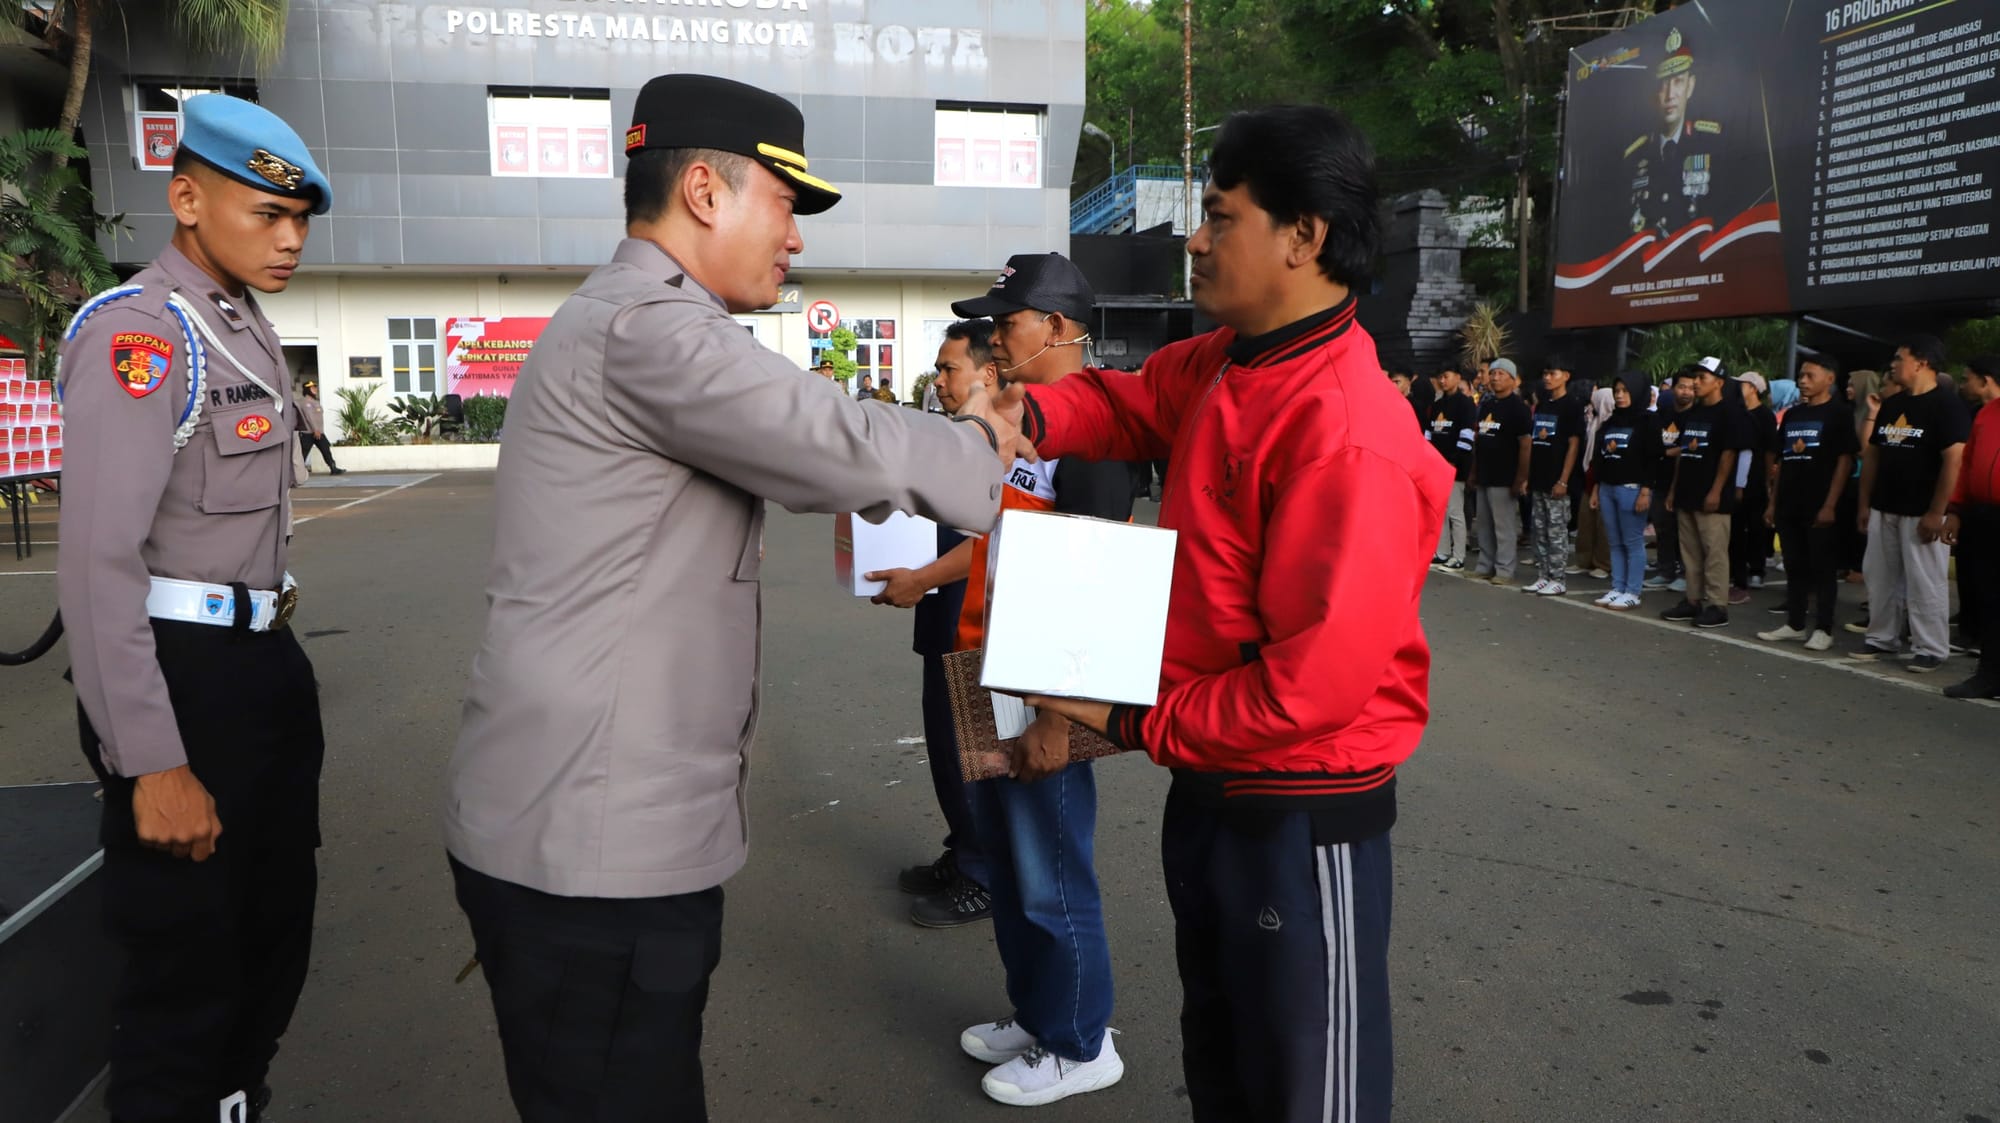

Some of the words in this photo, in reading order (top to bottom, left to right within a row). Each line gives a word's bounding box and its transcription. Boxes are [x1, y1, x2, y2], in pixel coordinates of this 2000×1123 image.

[448, 10, 596, 38] POLRESTA
[605, 15, 729, 43] MALANG
[737, 21, 809, 47] KOTA
[1825, 8, 1841, 33] 16
[1843, 0, 1915, 27] PROGR
[1836, 38, 1867, 56] PENATAAN
[1867, 23, 1915, 46] KELEMBAGAAN
[1872, 46, 1895, 61] SISTEM
[1910, 32, 1938, 50] METODE
[1938, 19, 1982, 41] ORGANISASI
[1887, 57, 1907, 73] POLRI
[1908, 52, 1926, 67] YANG
[1926, 45, 1954, 61] UNGGUL
[1964, 37, 1979, 51] ERA
[1869, 74, 1905, 93] TEKNOLOGI
[1904, 64, 1944, 84] KEPOLISIAN
[1898, 79, 1951, 102] PEMELIHARAAN
[1951, 67, 1996, 88] KAMTIBMAS
[1898, 98, 1938, 117] PENEGAKAN
[1938, 91, 1965, 108] HUKUM
[1905, 117, 1926, 132] POLRI
[1926, 111, 1951, 127] DALAM
[1893, 135, 1926, 150] NASIONAL
[1926, 129, 1947, 145] (PEN)
[1895, 149, 1928, 166] PROGRAM
[1928, 142, 1965, 159] PRIORITAS
[1904, 165, 1933, 180] KONFLIK
[1933, 160, 1958, 175] SOSIAL
[1866, 188, 1896, 202] KUALITAS
[1896, 181, 1935, 198] PELAYANAN
[1935, 176, 1961, 191] PUBLIK
[1961, 172, 1982, 187] POLRI
[1865, 202, 1903, 219] PELAYANAN
[1902, 199, 1922, 213] POLRI
[1922, 196, 1941, 209] YANG
[1941, 188, 1992, 206] TERINTEGRASI
[1903, 215, 1928, 229] PUBLIK
[1895, 231, 1929, 246] TERHADAP
[1929, 227, 1954, 241] SETIAP
[1954, 223, 1990, 238] KEGIATAN
[1876, 265, 1919, 280] MASYARAKAT
[1919, 261, 1949, 275] PENCARI
[1949, 257, 1985, 272] KEADILAN
[817, 308, 832, 325] P
[115, 334, 171, 354] PROPAM
[457, 340, 483, 349] APEL
[211, 389, 222, 407] R
